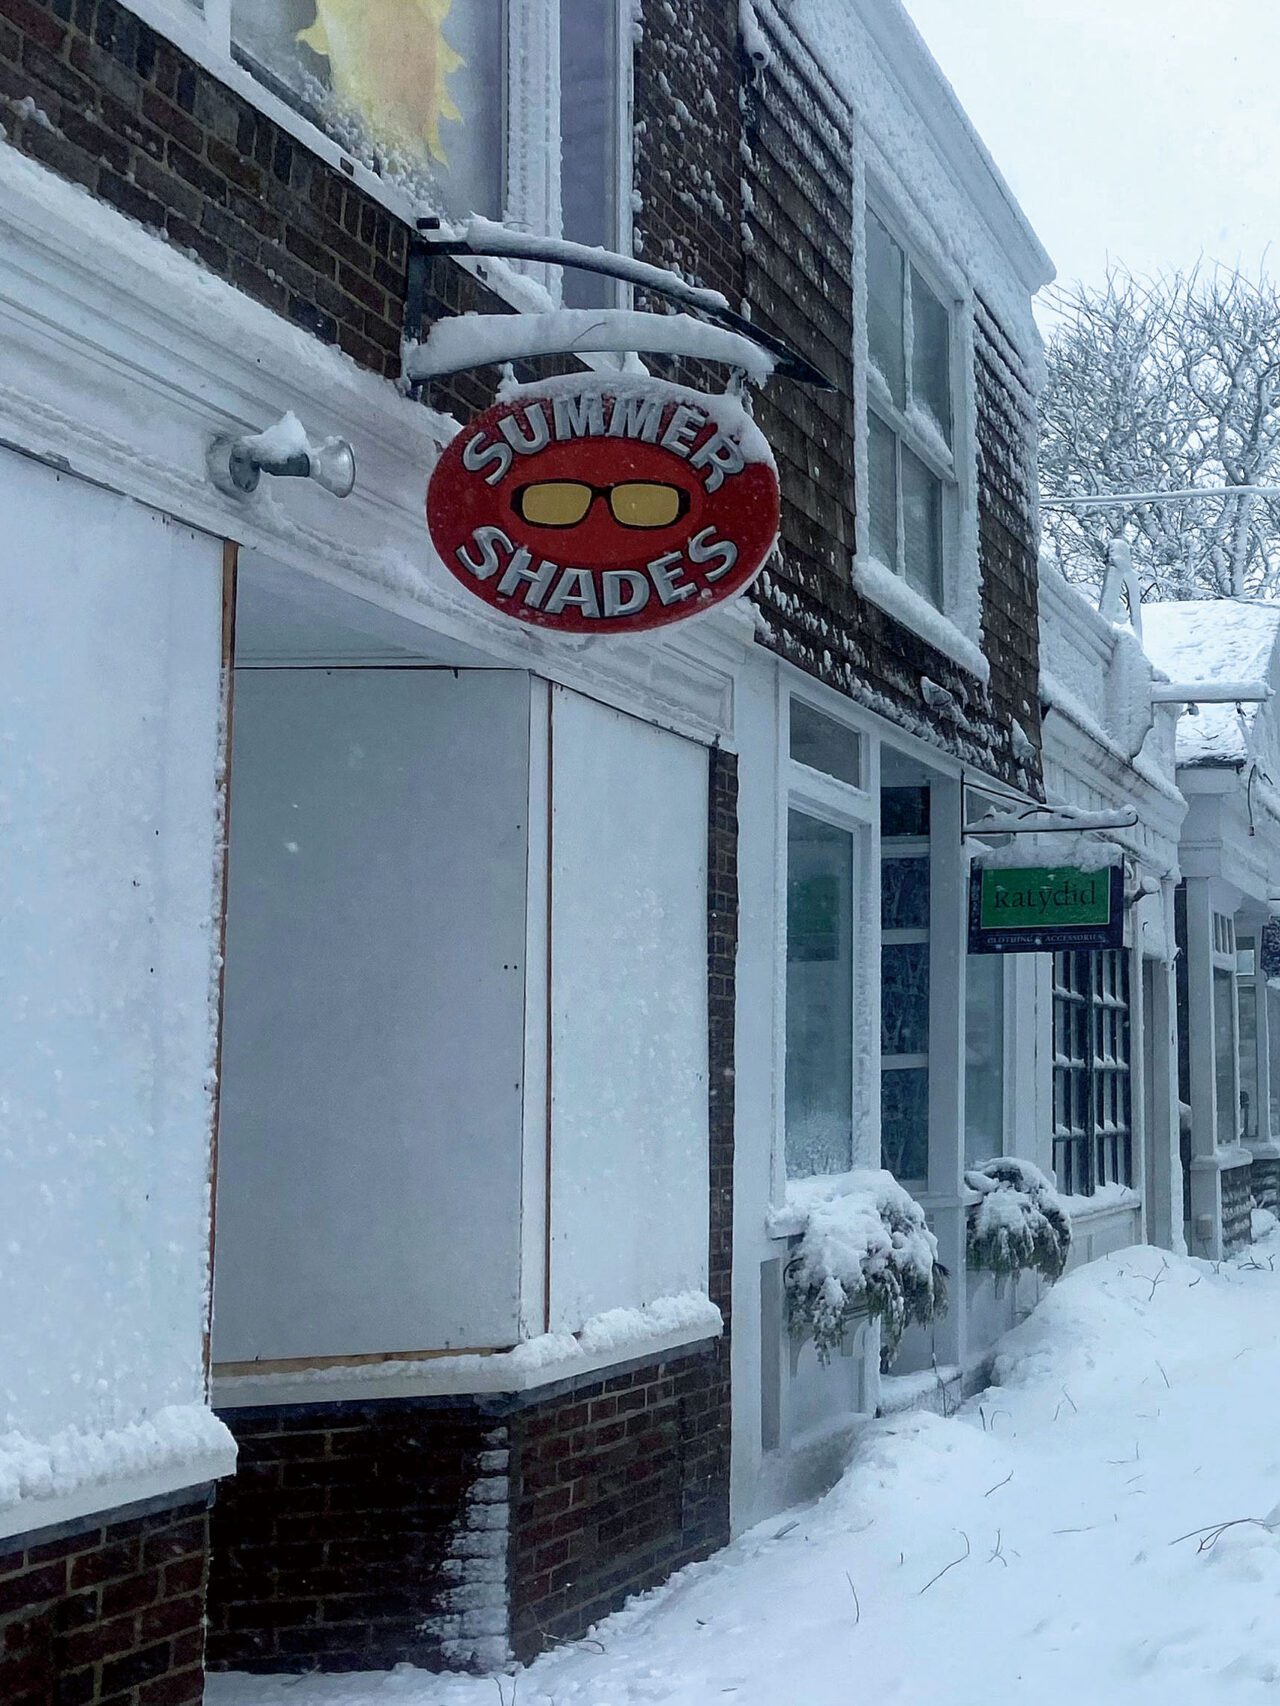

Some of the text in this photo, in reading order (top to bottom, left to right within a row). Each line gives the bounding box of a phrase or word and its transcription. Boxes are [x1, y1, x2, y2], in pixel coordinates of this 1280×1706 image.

[462, 393, 746, 494] SUMMER
[455, 526, 738, 618] SHADES
[987, 936, 1033, 944] CLOTHING
